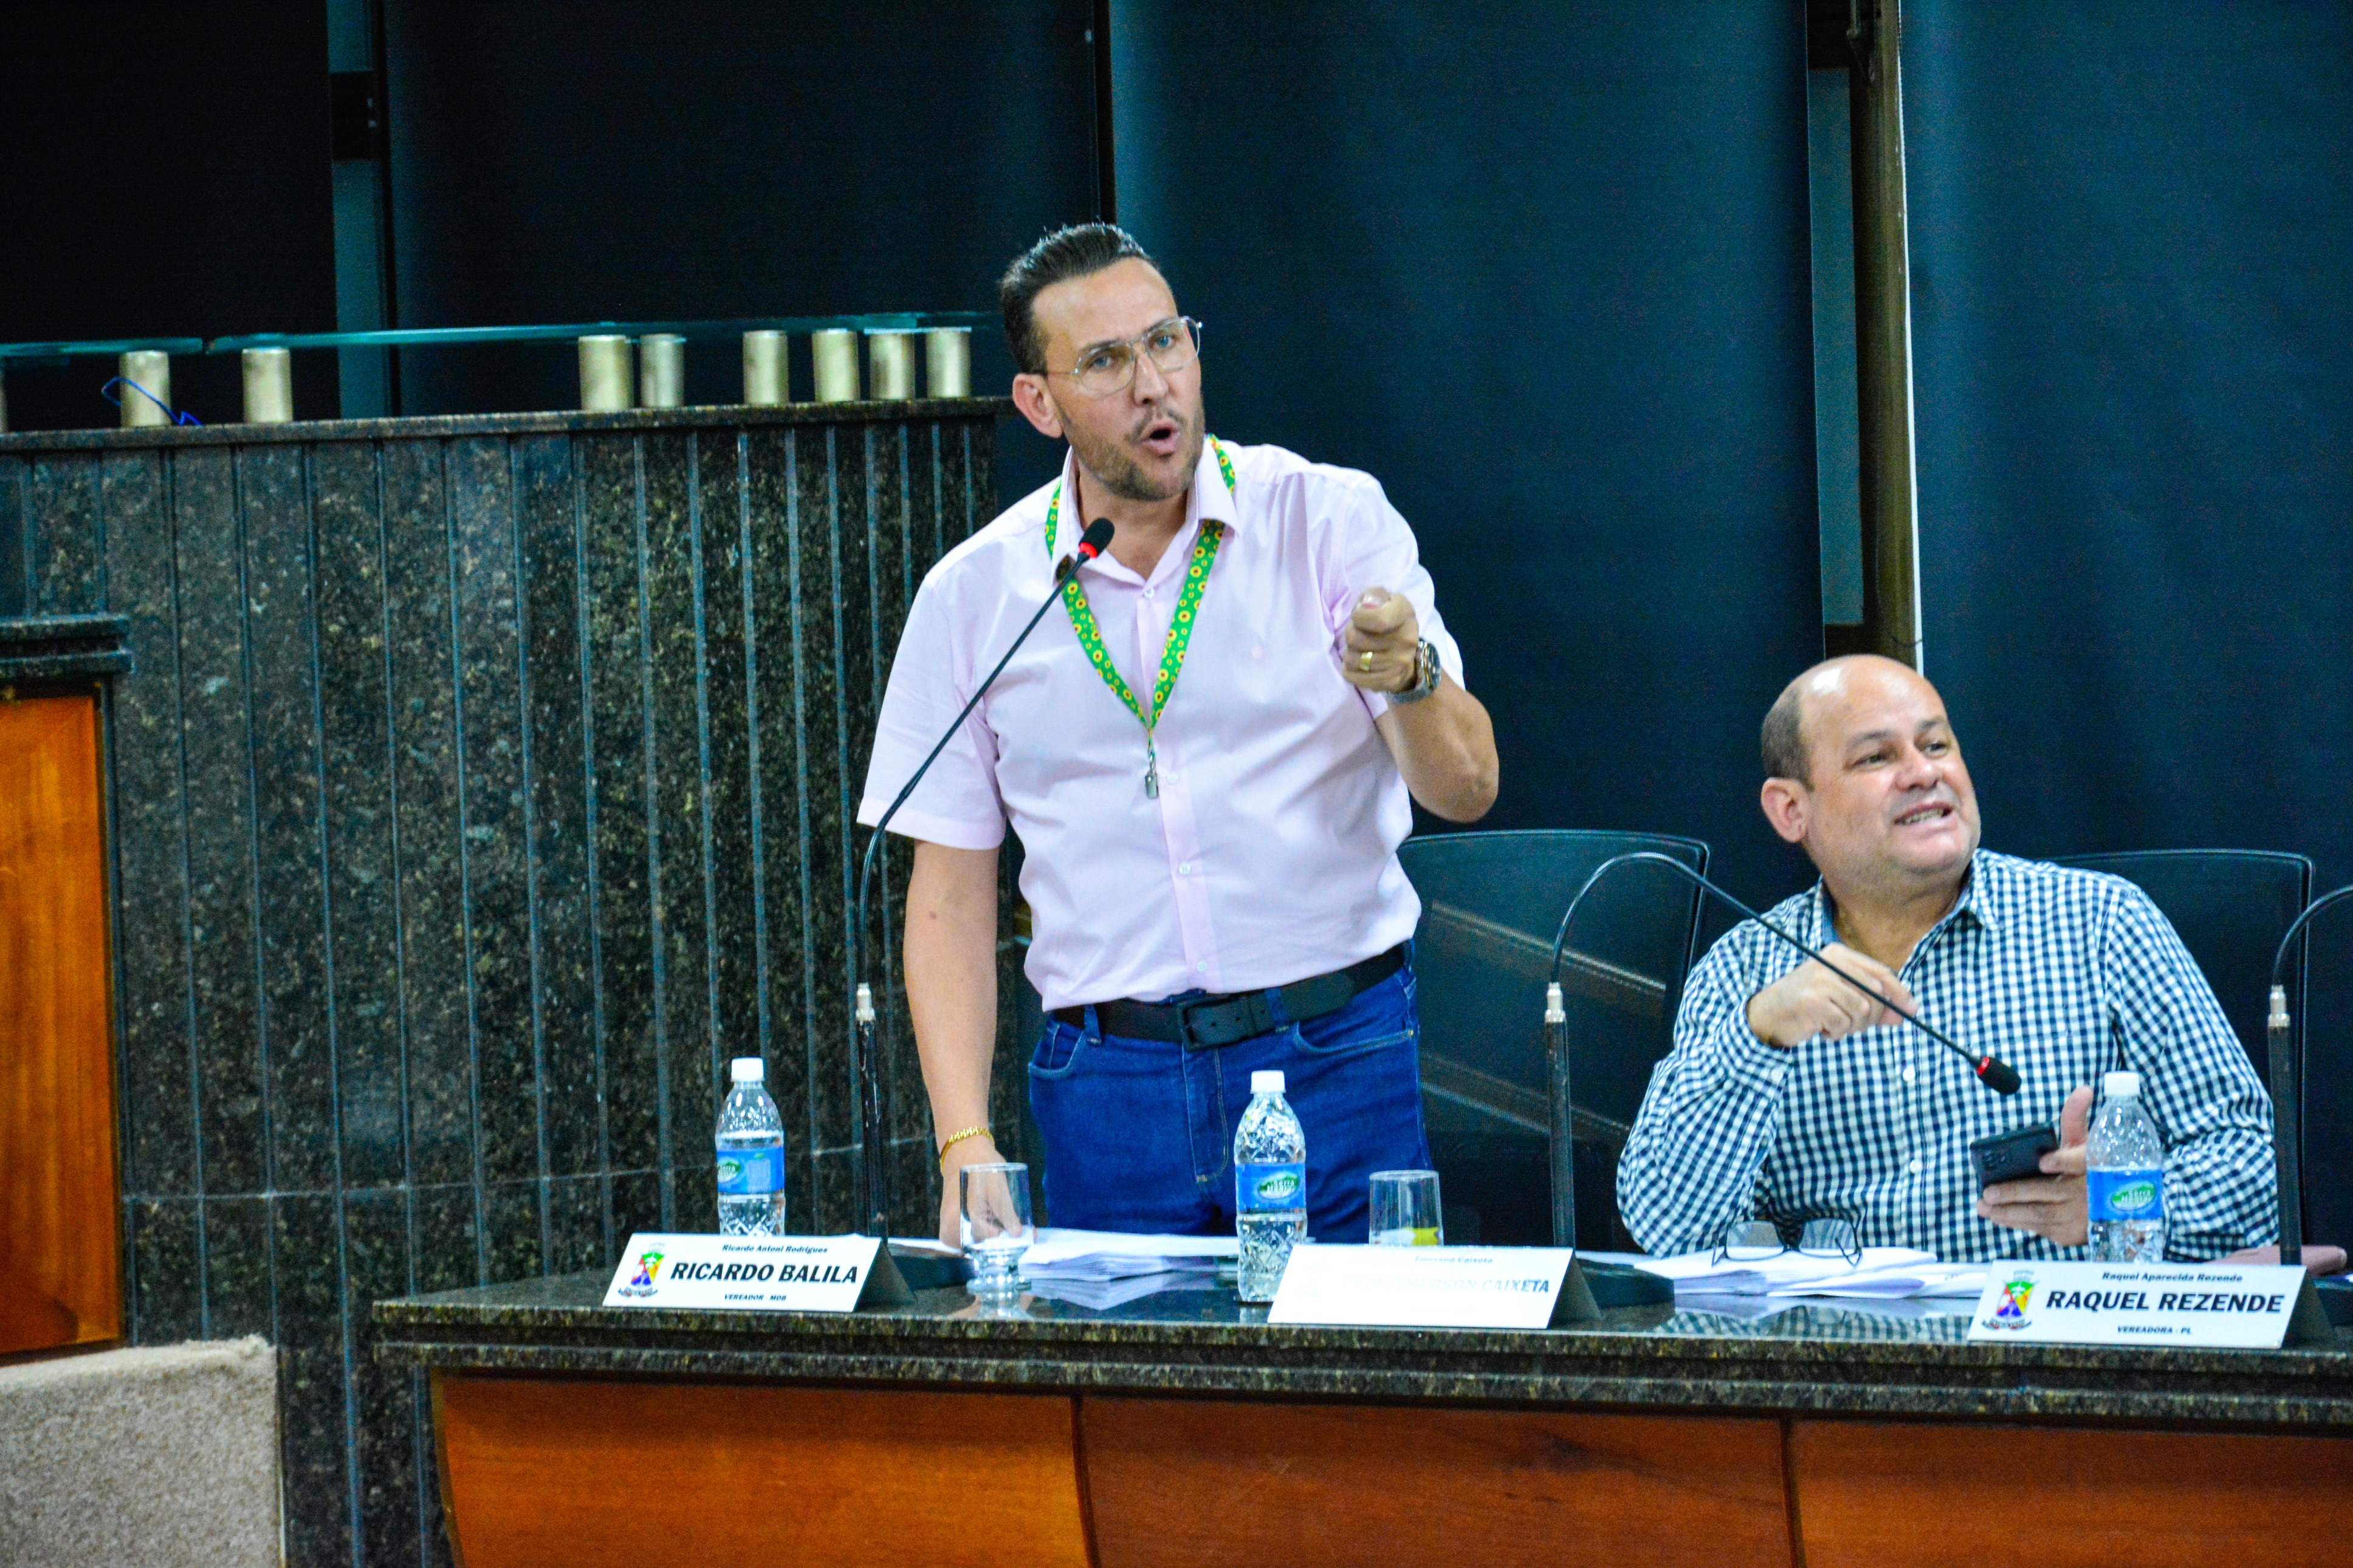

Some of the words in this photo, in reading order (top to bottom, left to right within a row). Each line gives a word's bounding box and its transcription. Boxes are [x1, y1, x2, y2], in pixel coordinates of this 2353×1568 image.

[785, 1245, 828, 1254] Rodrigues
[670, 1262, 774, 1281] RICARDO
[778, 1265, 857, 1283] BALILA
[2102, 1272, 2139, 1282] Raquel
[2141, 1273, 2194, 1282] Aparecida
[1395, 1278, 1475, 1290] EMERSON
[1482, 1278, 1550, 1293] CAIXETA
[2046, 1291, 2150, 1312] RAQUEL
[2157, 1293, 2285, 1313] REZENDE
